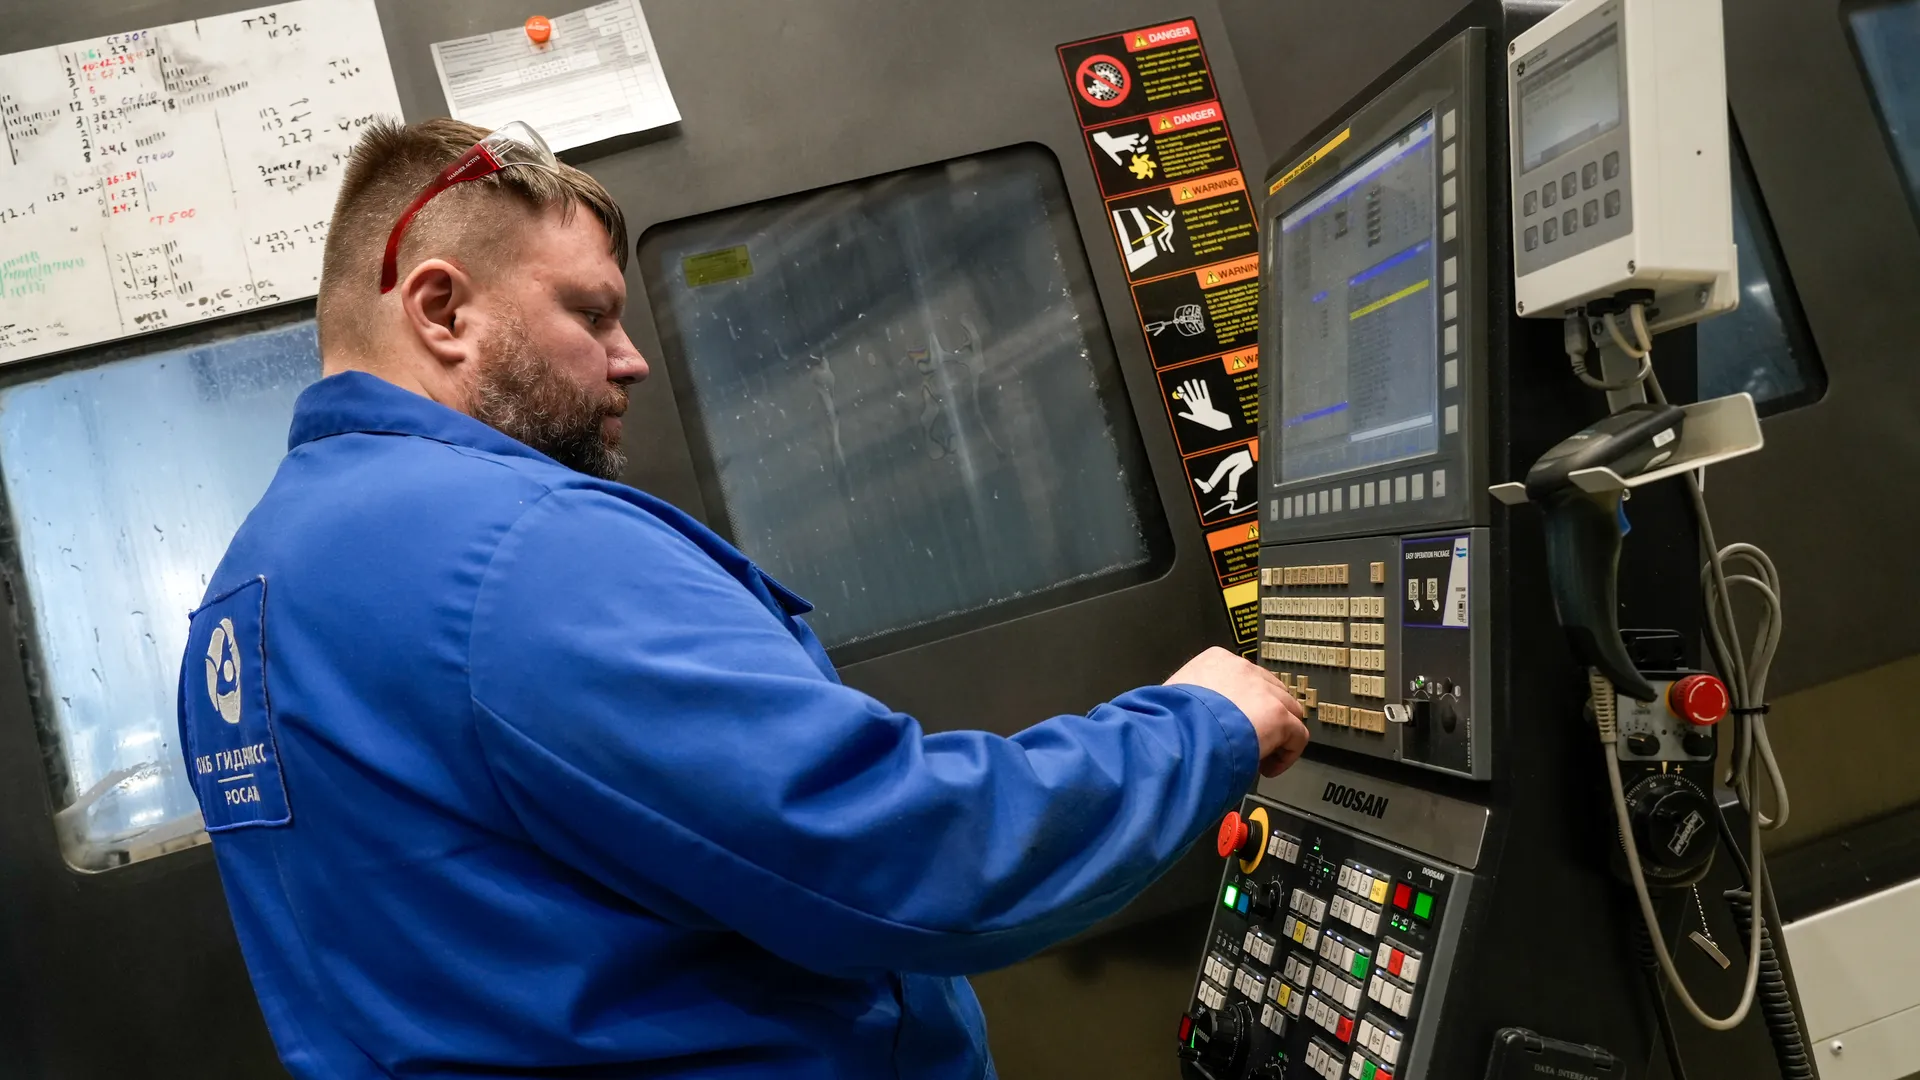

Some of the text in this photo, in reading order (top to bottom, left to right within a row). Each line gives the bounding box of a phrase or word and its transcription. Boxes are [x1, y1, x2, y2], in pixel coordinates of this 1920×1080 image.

[1148, 26, 1191, 43] DANGER
[1173, 108, 1216, 126] DANGER
[465, 155, 481, 169] ACTIVE
[1192, 177, 1239, 195] WARNING
[1218, 262, 1259, 279] WARNIN
[1405, 549, 1451, 560] EASY OPERATION PACKAGE
[1321, 781, 1389, 820] DOOSAN
[1421, 867, 1446, 882] DOOSAN
[1534, 1063, 1555, 1076] DATA
